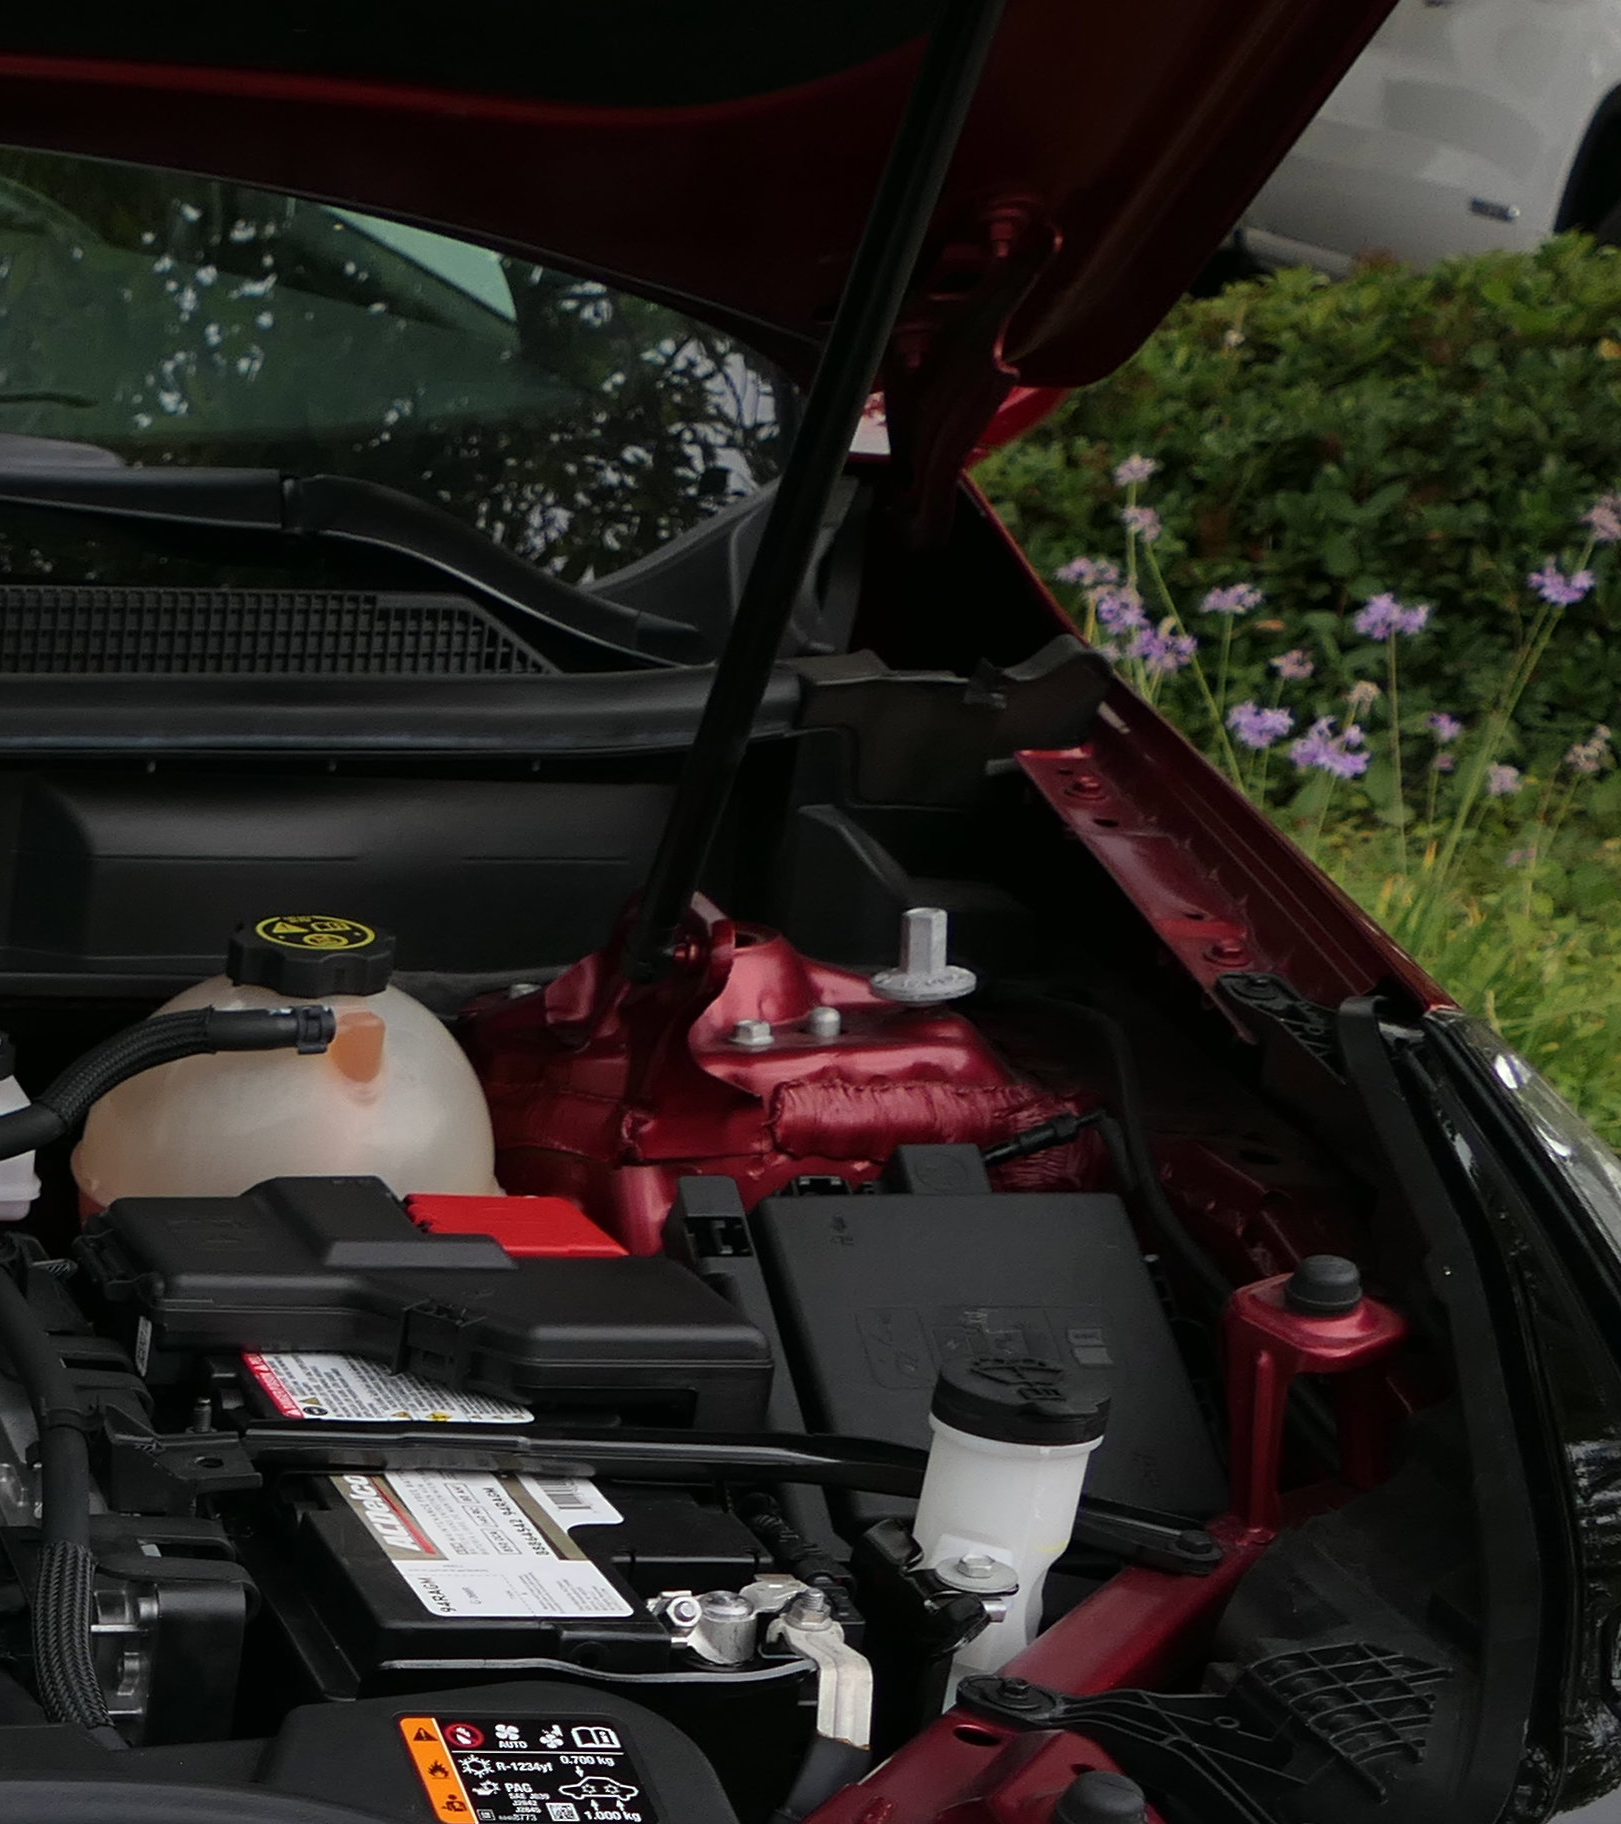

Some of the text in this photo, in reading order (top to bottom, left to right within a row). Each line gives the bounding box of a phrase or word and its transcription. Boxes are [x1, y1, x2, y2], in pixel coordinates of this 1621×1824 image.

[481, 1487, 516, 1515] 94RAGM
[339, 1475, 421, 1551] ACDelco
[417, 1577, 458, 1613] 94RAGM
[498, 1740, 528, 1749] AUTO
[560, 1756, 615, 1766] 0.700 kg
[496, 1761, 553, 1773] R-1234yf
[505, 1783, 533, 1792] PAG
[584, 1811, 641, 1822] 1.000 kg
